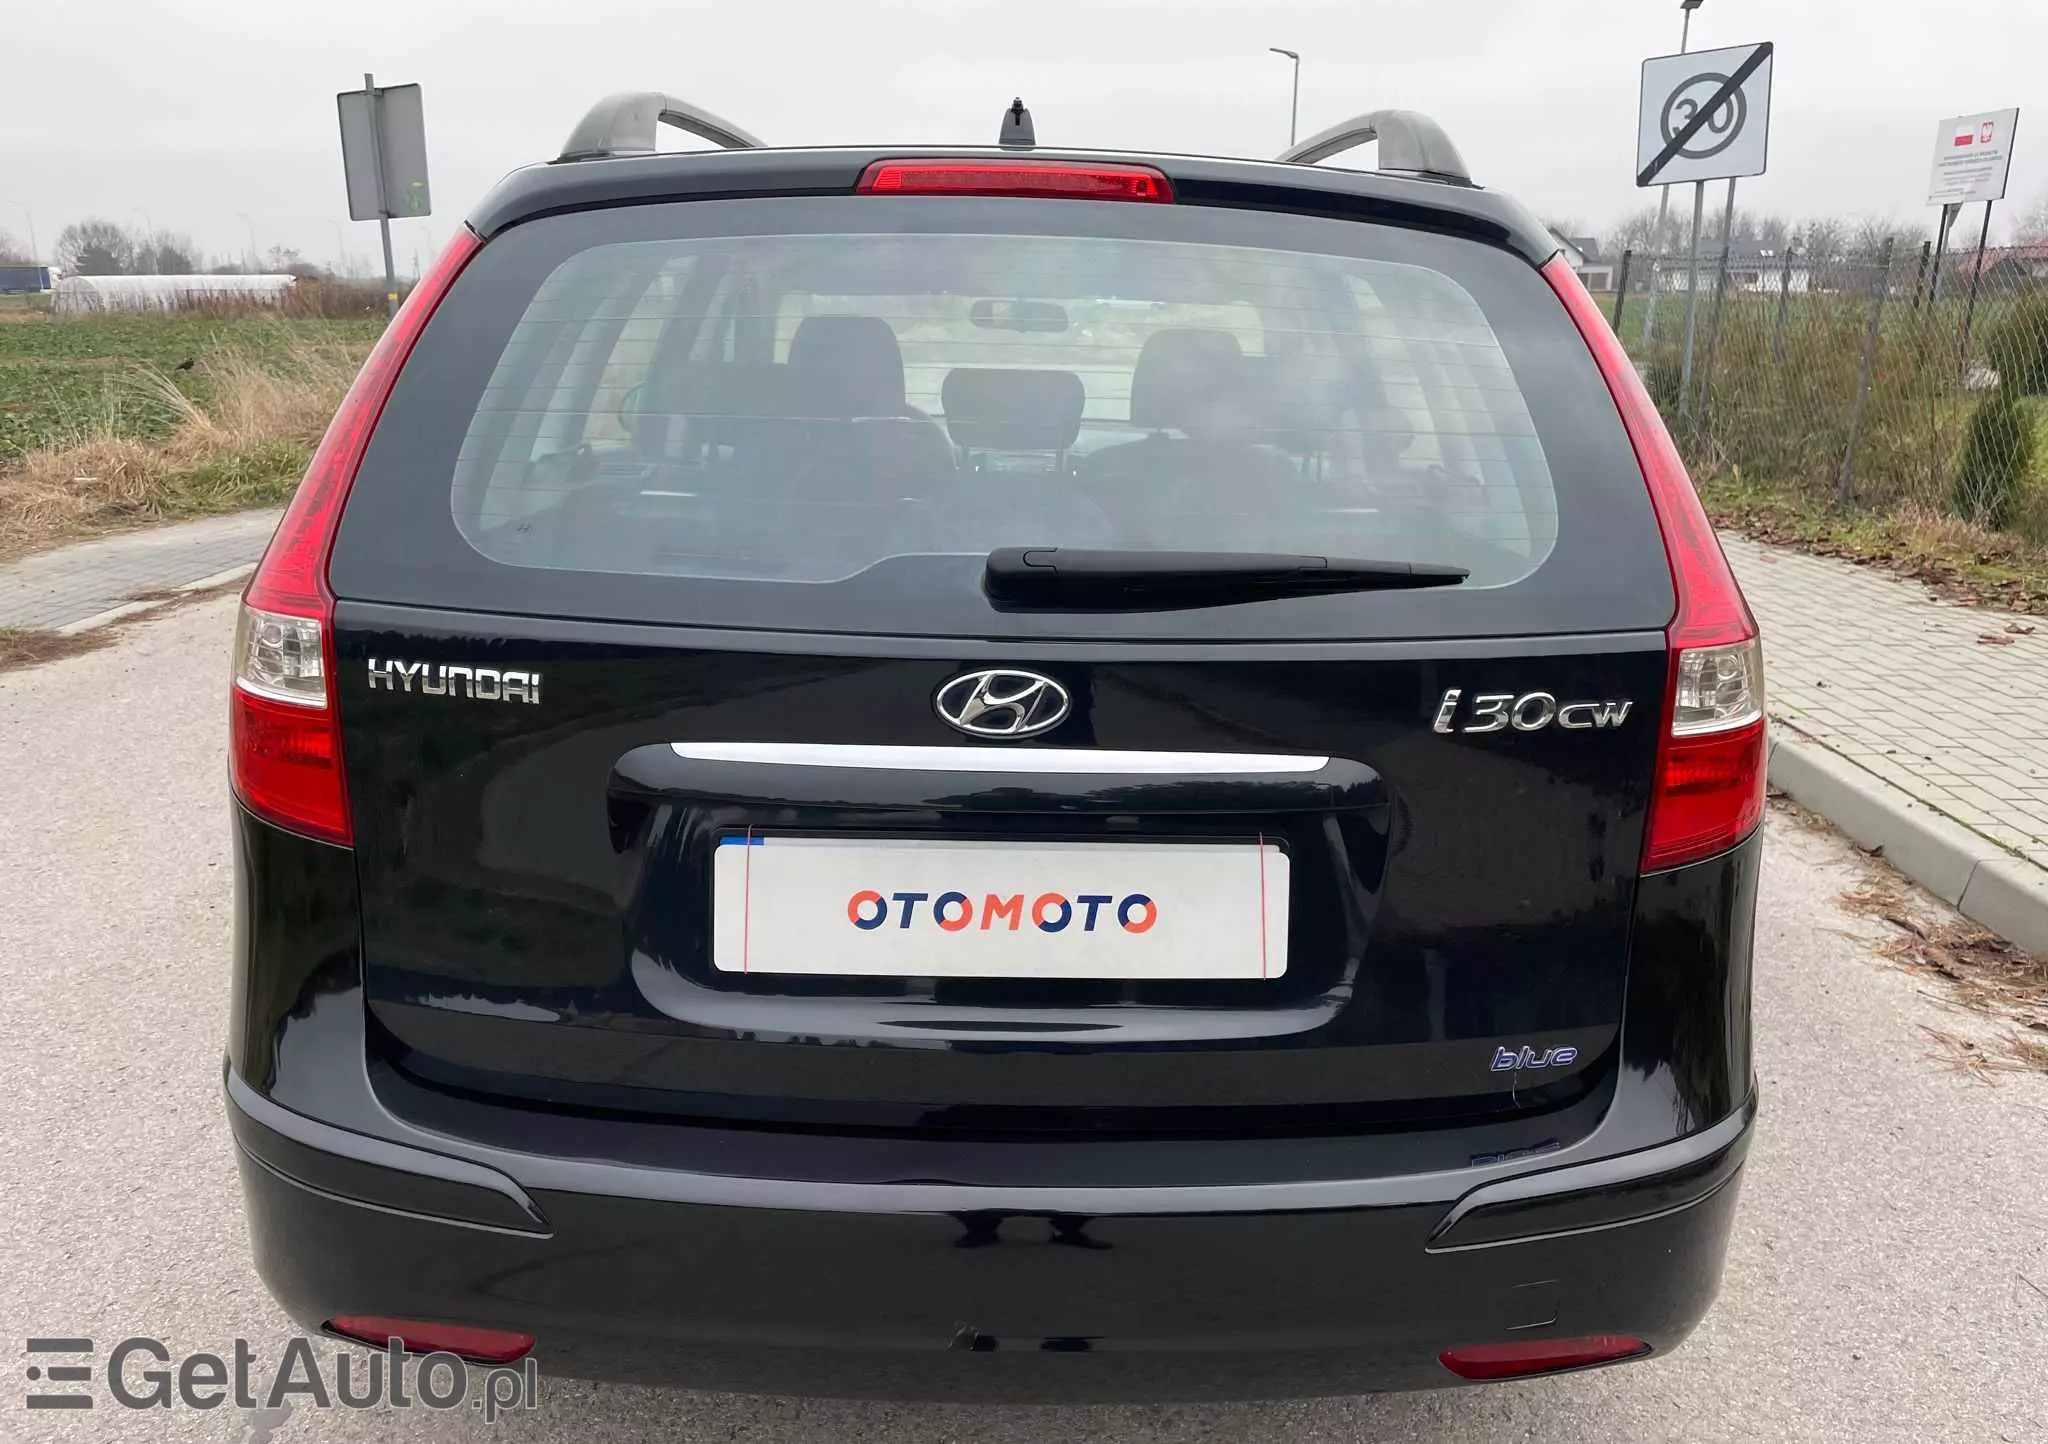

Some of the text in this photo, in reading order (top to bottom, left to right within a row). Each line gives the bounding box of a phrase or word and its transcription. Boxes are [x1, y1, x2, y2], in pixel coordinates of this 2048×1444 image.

[367, 658, 540, 705] HYUNDAI
[847, 889, 1158, 934] OTOMOTO
[1490, 1045, 1578, 1072] blue
